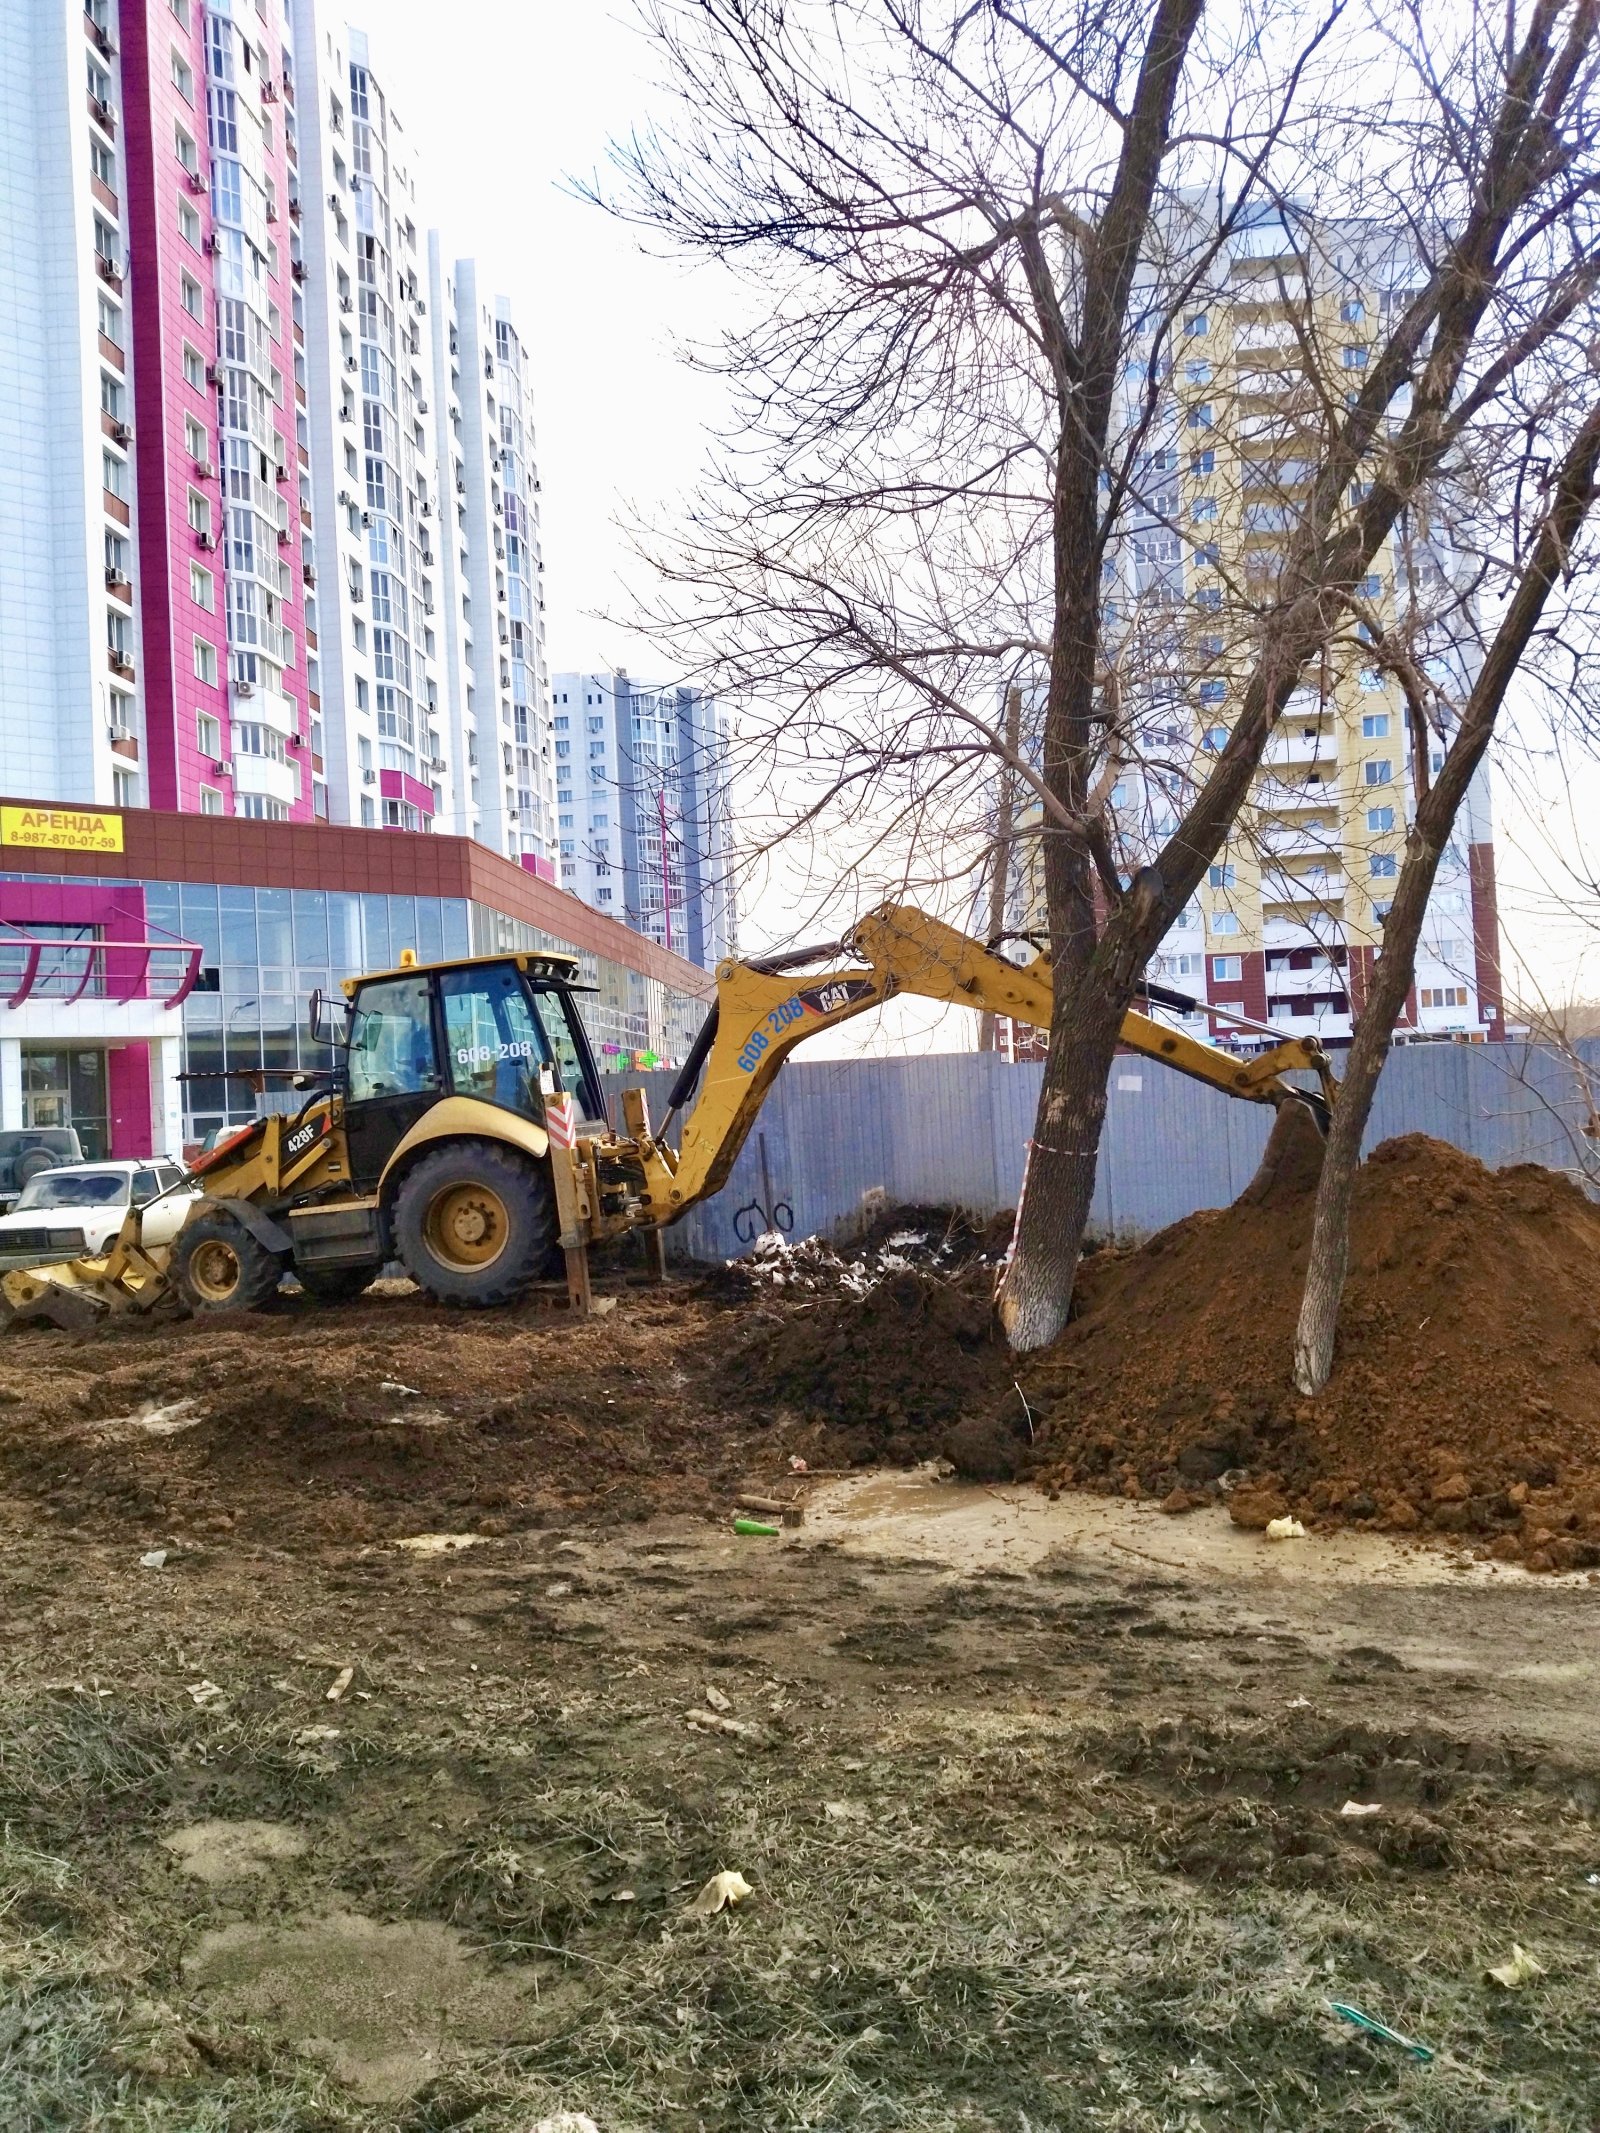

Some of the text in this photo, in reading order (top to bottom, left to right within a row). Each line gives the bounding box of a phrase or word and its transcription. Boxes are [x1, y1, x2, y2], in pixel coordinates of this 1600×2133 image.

[21, 812, 106, 834] АРЕНДА
[10, 831, 116, 848] 8-987-870-07-59
[819, 982, 851, 1012] CAT
[737, 997, 804, 1073] 608-208
[457, 1041, 532, 1064] 608-208
[287, 1124, 314, 1152] 428F
